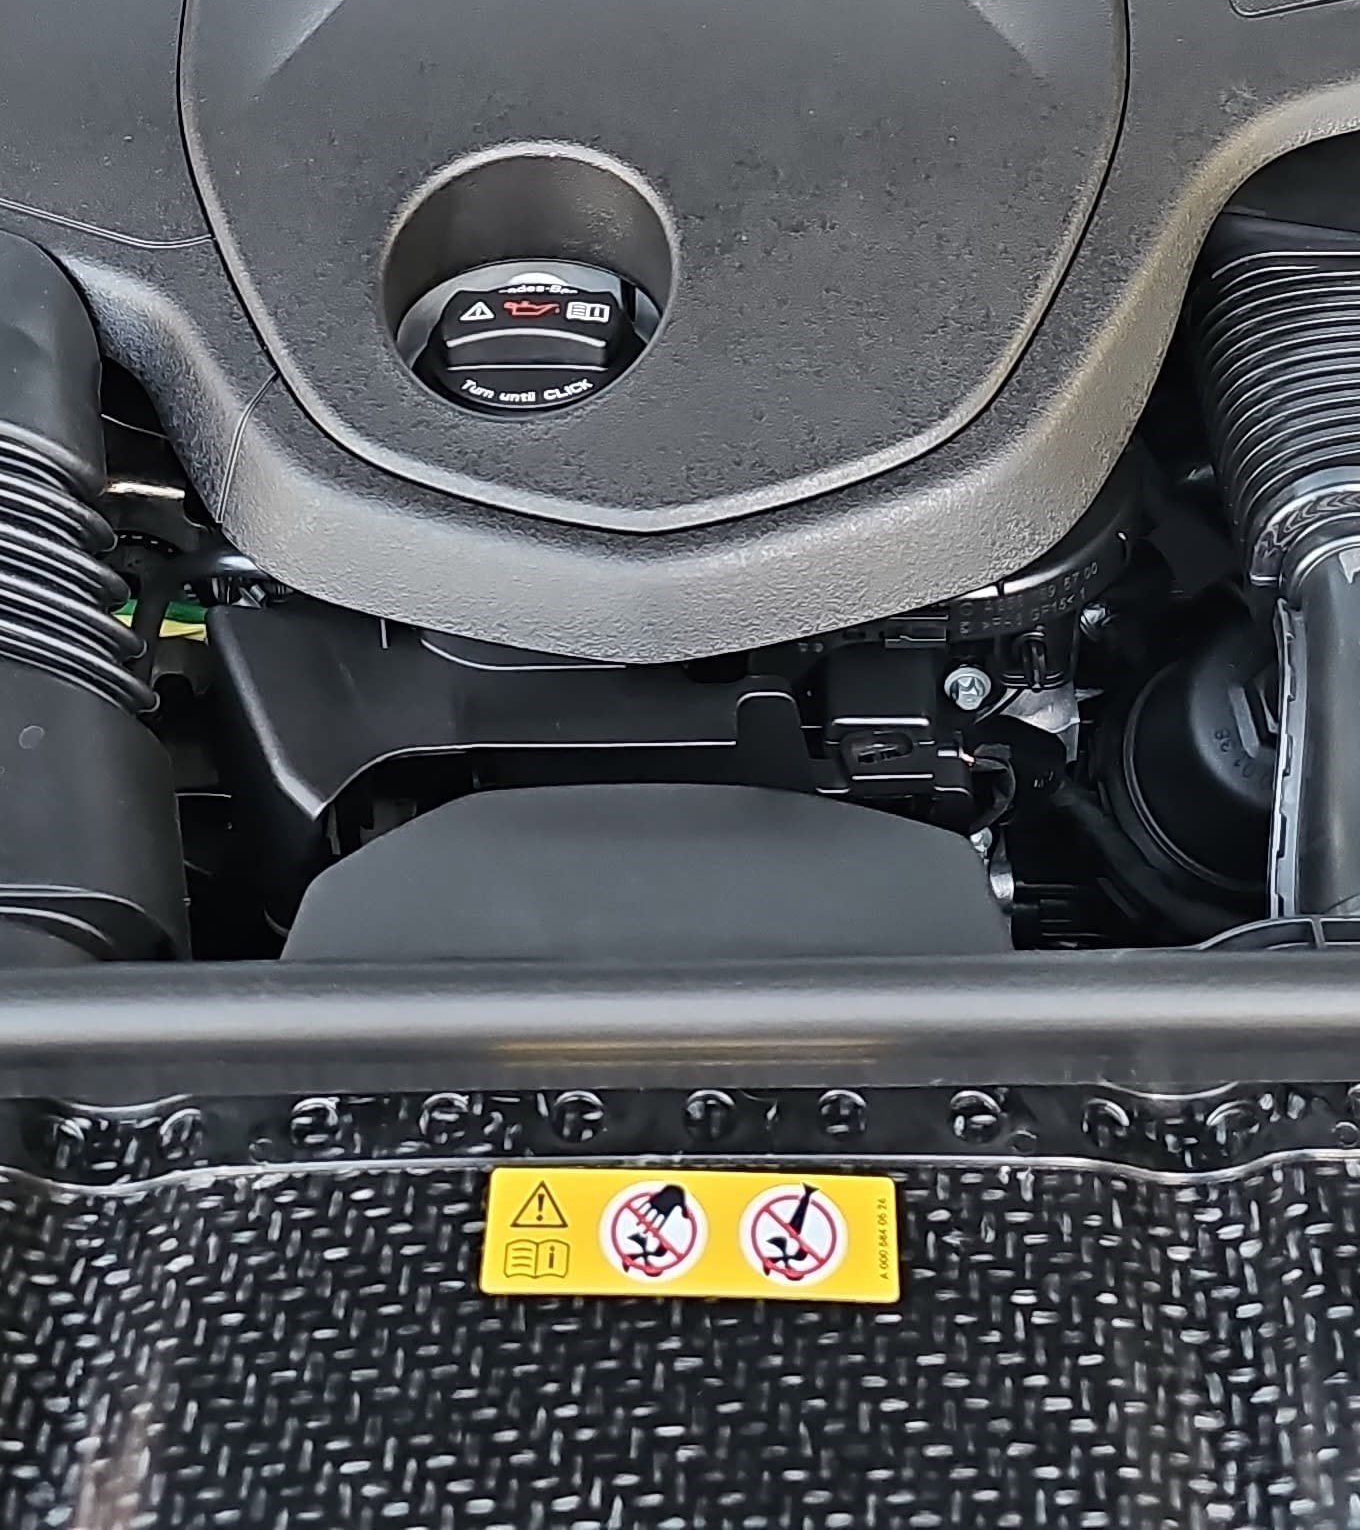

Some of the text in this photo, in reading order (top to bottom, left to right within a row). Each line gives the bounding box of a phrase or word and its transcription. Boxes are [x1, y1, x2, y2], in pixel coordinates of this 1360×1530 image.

[460, 379, 594, 402] Turn until CLICK
[878, 1250, 889, 1270] 000
